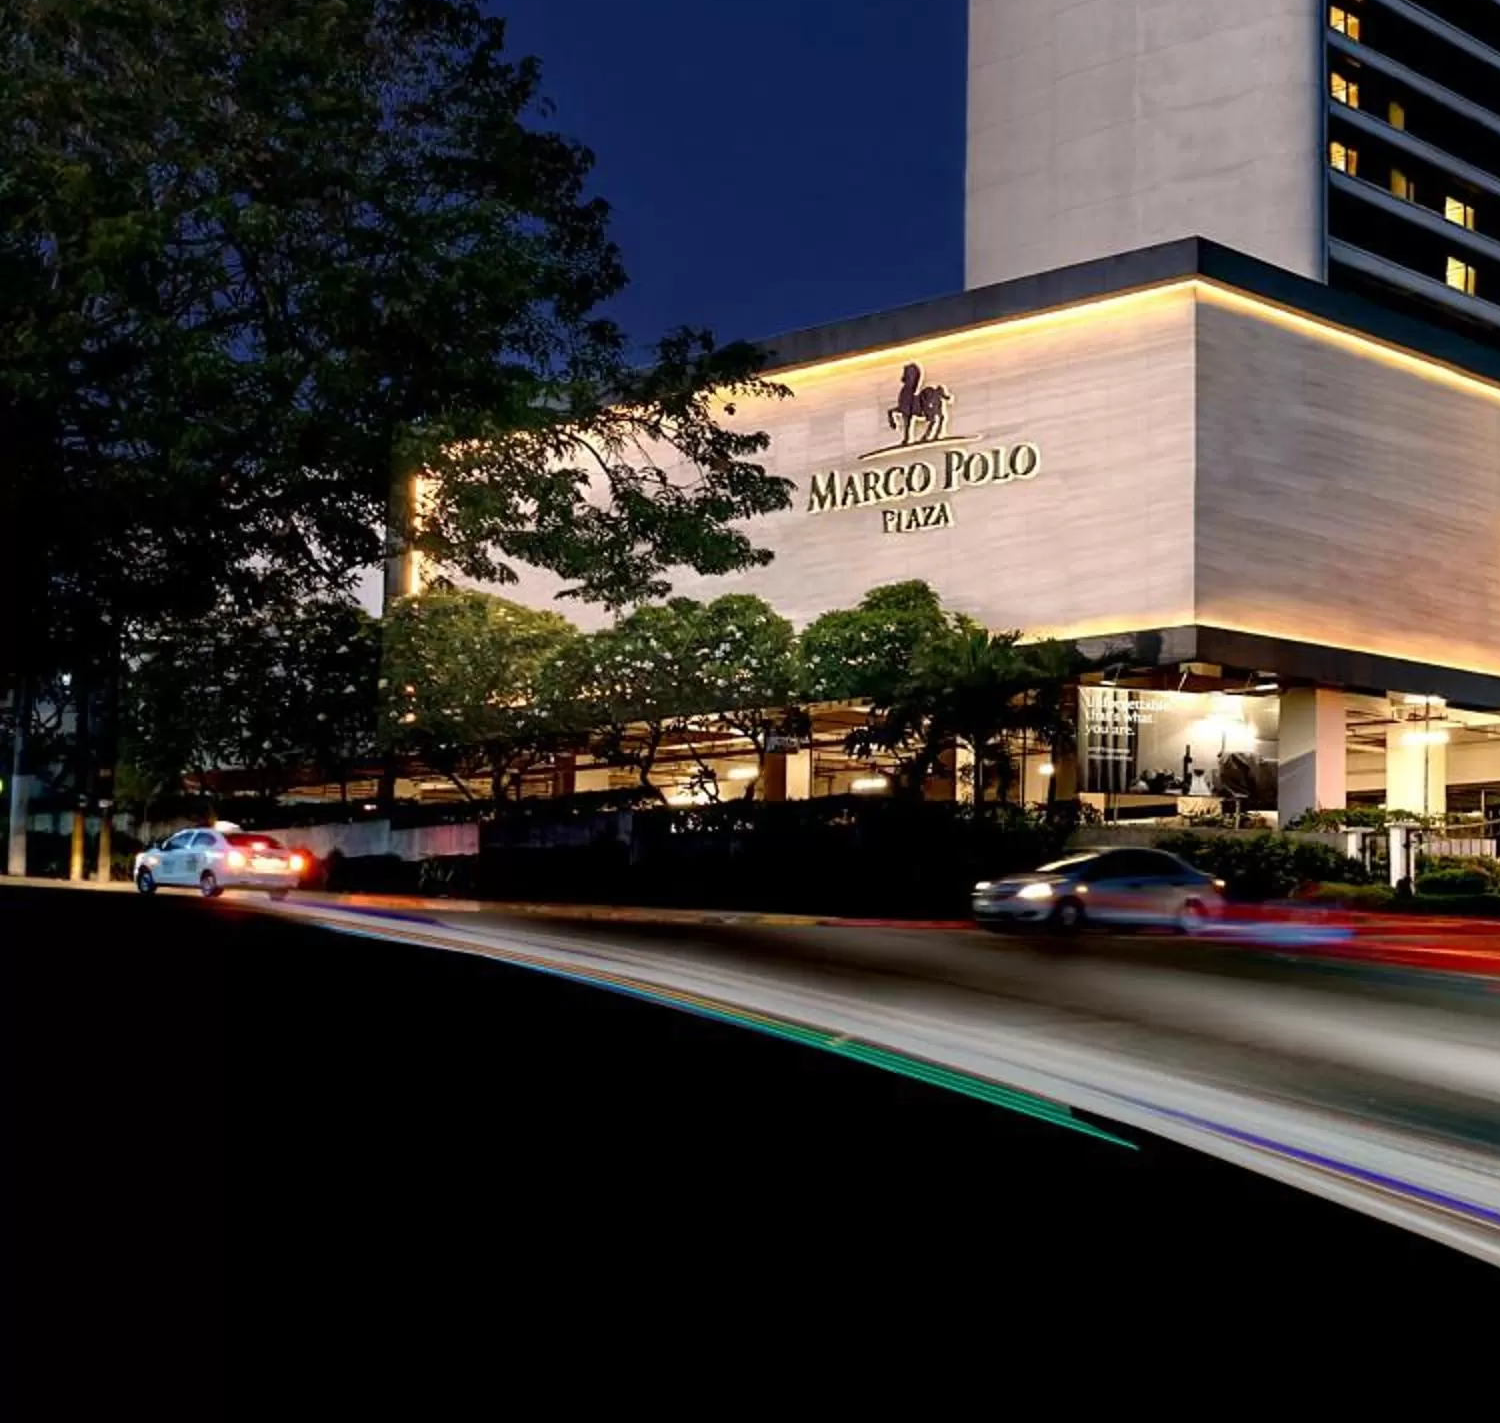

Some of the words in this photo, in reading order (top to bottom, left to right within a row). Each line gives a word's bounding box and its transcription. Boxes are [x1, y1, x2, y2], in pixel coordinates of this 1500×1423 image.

[807, 461, 934, 514] MARCO
[942, 442, 1040, 492] POLO
[881, 502, 954, 534] PLAZA
[1084, 723, 1109, 736] you
[1111, 724, 1136, 736] are.
